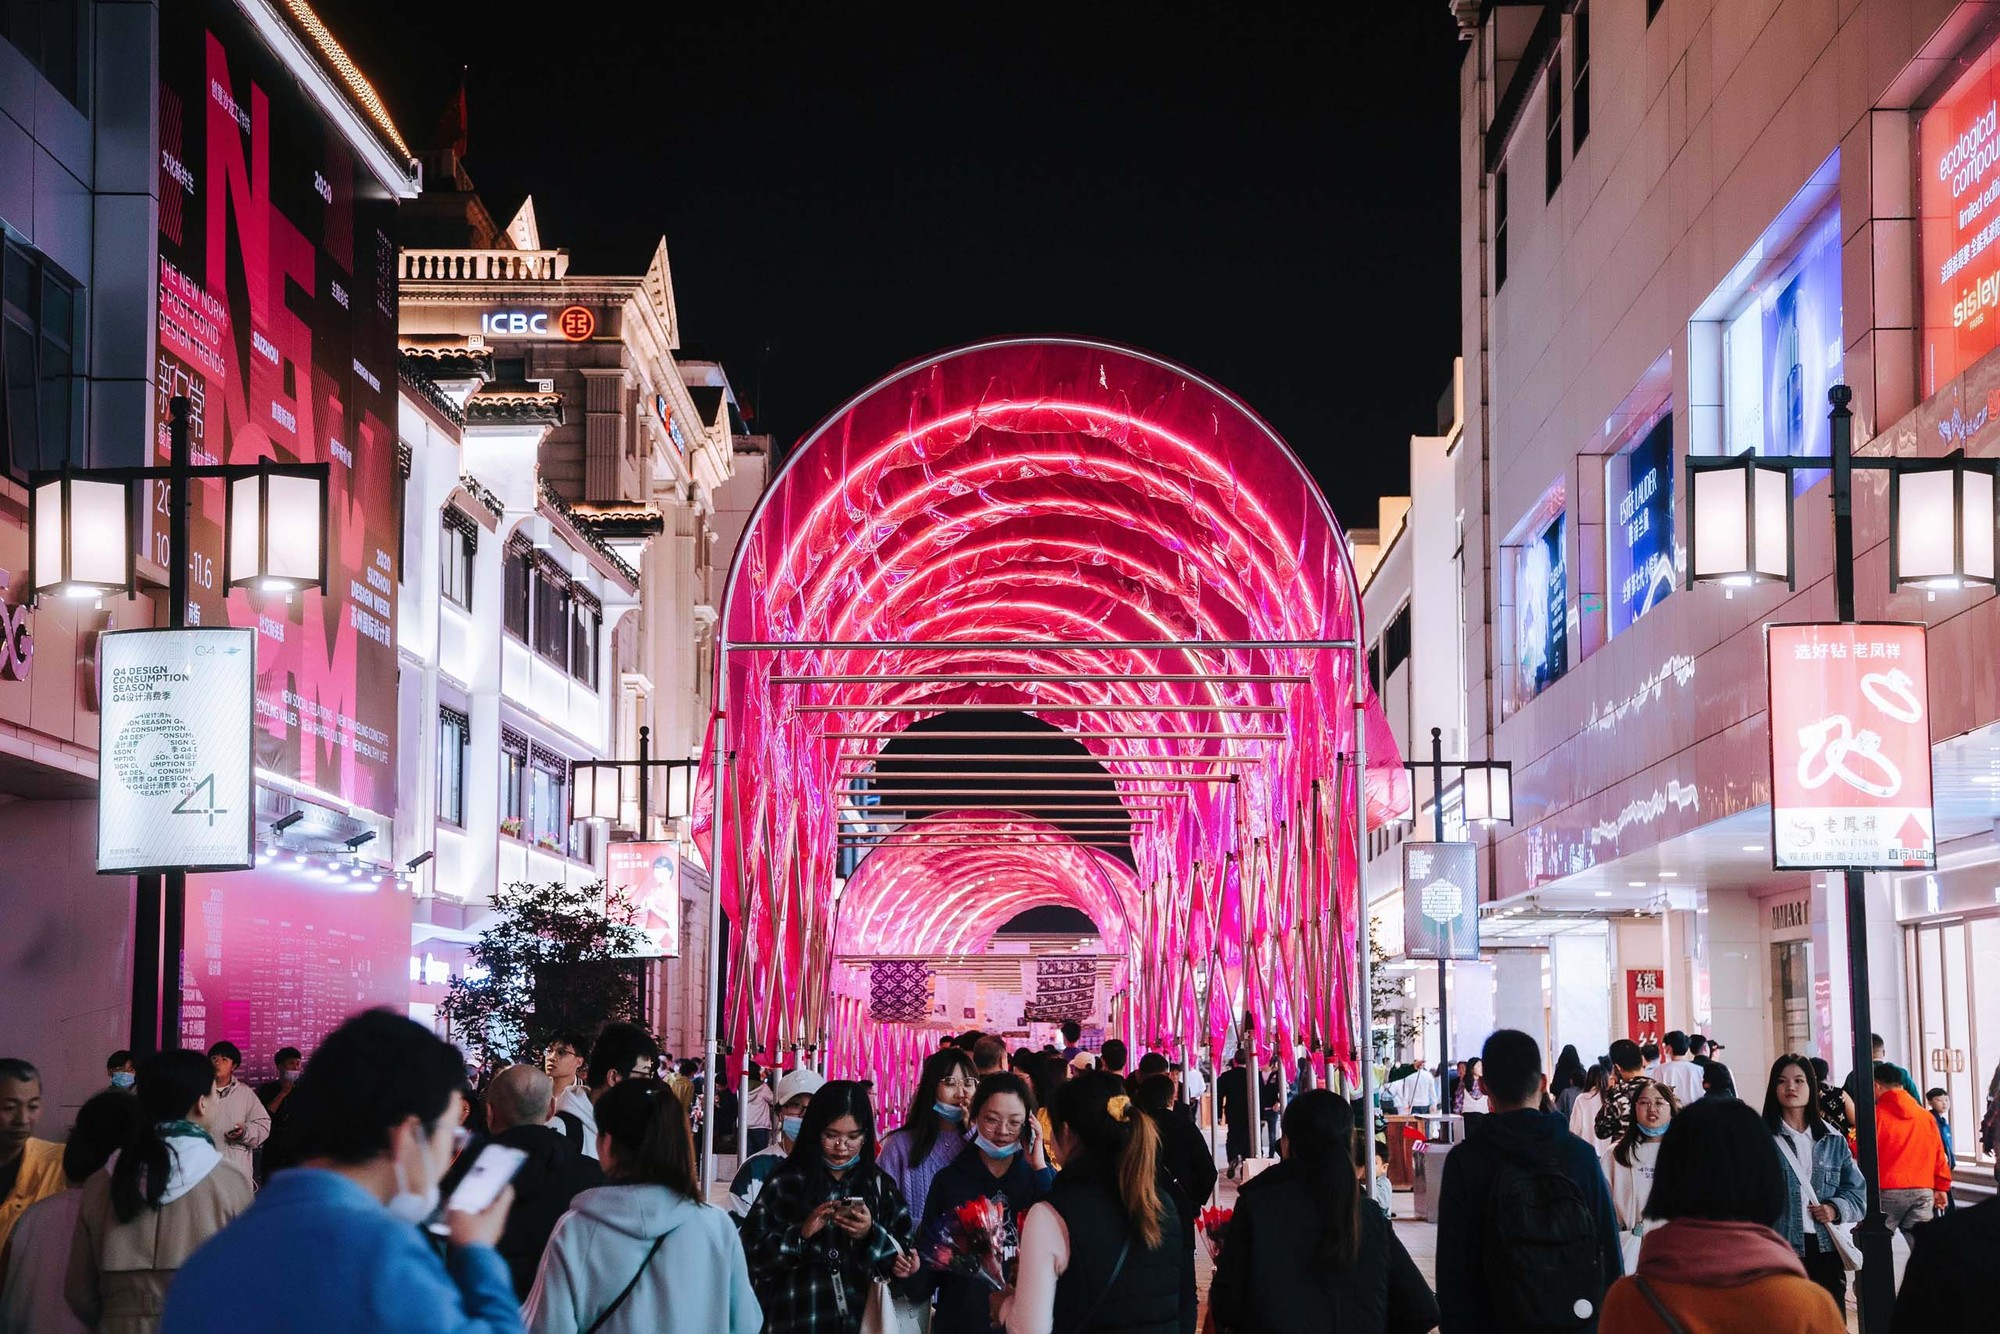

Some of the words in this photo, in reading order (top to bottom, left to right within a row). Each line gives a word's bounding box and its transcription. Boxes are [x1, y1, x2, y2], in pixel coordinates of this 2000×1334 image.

[1940, 99, 1996, 181] ecological
[314, 170, 332, 204] 2020
[1959, 192, 1983, 231] limited
[159, 254, 176, 286] THE
[180, 270, 200, 302] NEW
[202, 291, 228, 328] NORM:
[1953, 270, 2000, 328] sisley
[159, 283, 165, 304] 5
[167, 289, 219, 346] POST-COVID
[482, 313, 548, 335] ICBC
[159, 310, 191, 351] DESIGN
[193, 337, 225, 378] TRENDS
[253, 330, 279, 365] SUZHOU
[1634, 467, 1657, 510] LAUDER
[376, 547, 391, 573] 2020
[367, 566, 391, 596] SUZHOU
[351, 579, 373, 609] DESIGN
[373, 593, 391, 620] WEEK
[350, 603, 391, 649] 苏州国际设计周
[1794, 642, 1847, 660] 选好钻
[1853, 642, 1901, 659] 老凤祥
[113, 668, 126, 676] Q4
[129, 666, 168, 675] DESIGN
[113, 674, 189, 684] CONSUMPTION
[113, 683, 153, 693] SEASON
[113, 691, 171, 702] Q4设计消费季
[131, 725, 187, 733] CONSUMPTION
[141, 718, 172, 726] SEASON
